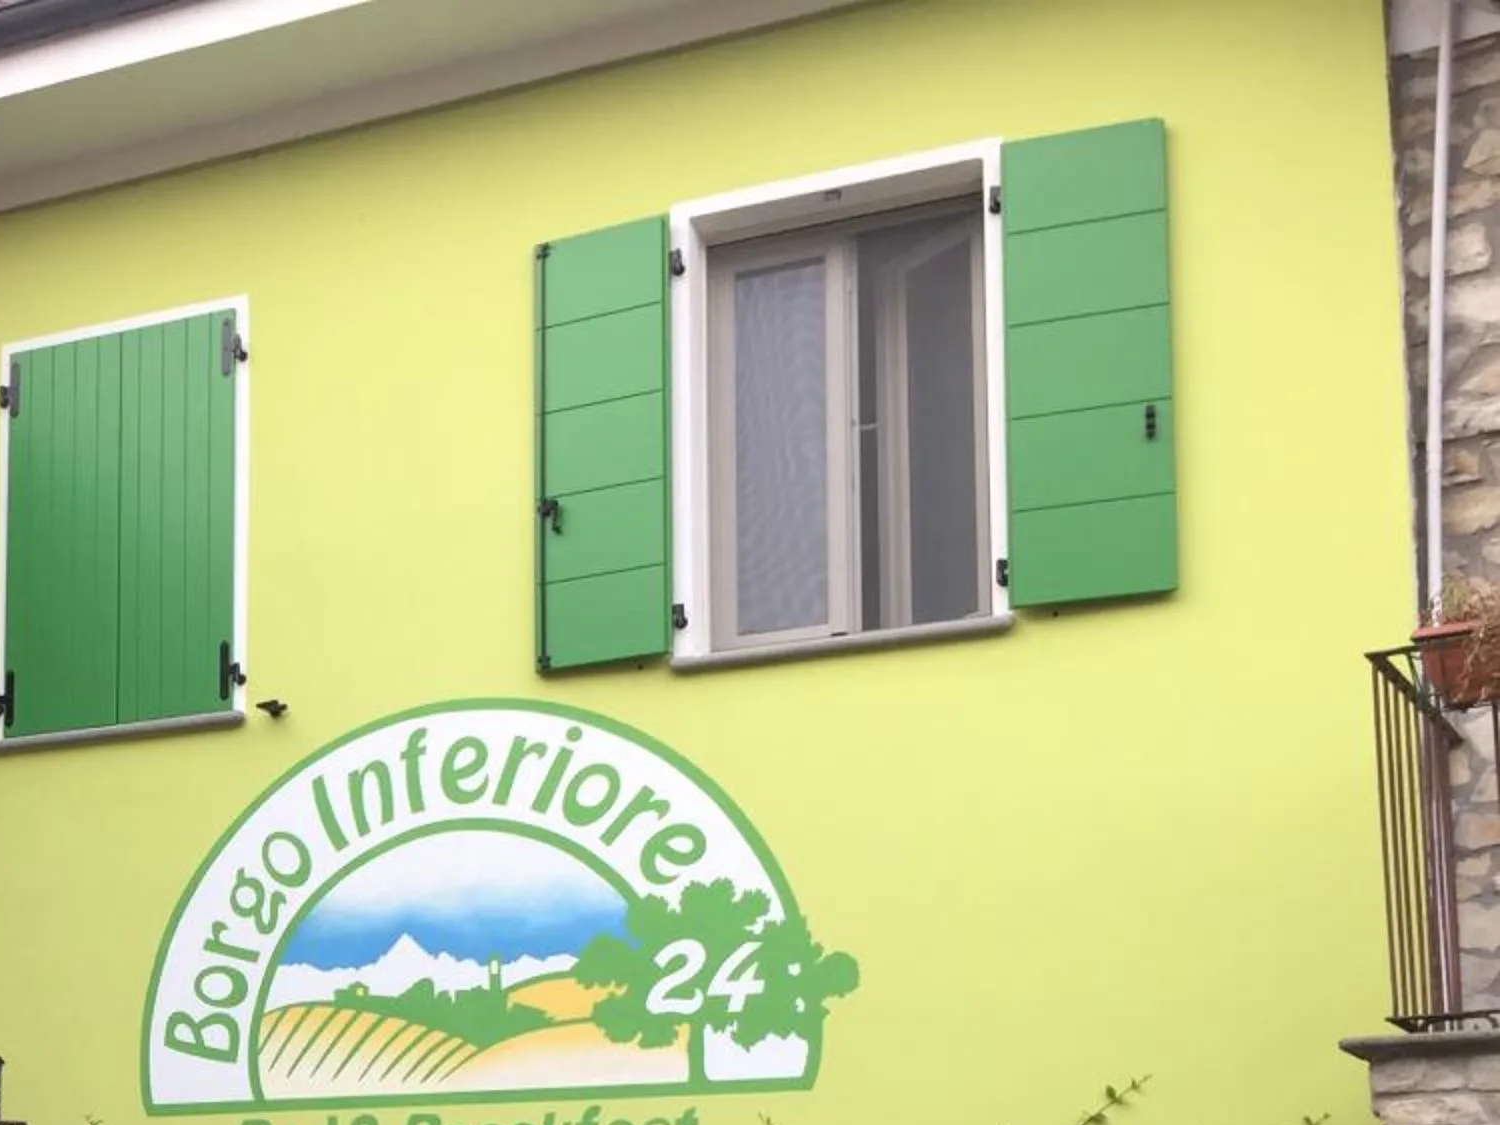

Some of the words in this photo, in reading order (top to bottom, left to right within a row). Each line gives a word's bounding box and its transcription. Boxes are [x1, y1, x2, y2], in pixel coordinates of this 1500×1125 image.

[164, 832, 312, 1064] Borgo
[312, 726, 707, 886] Inferiore
[646, 939, 765, 1014] 24
